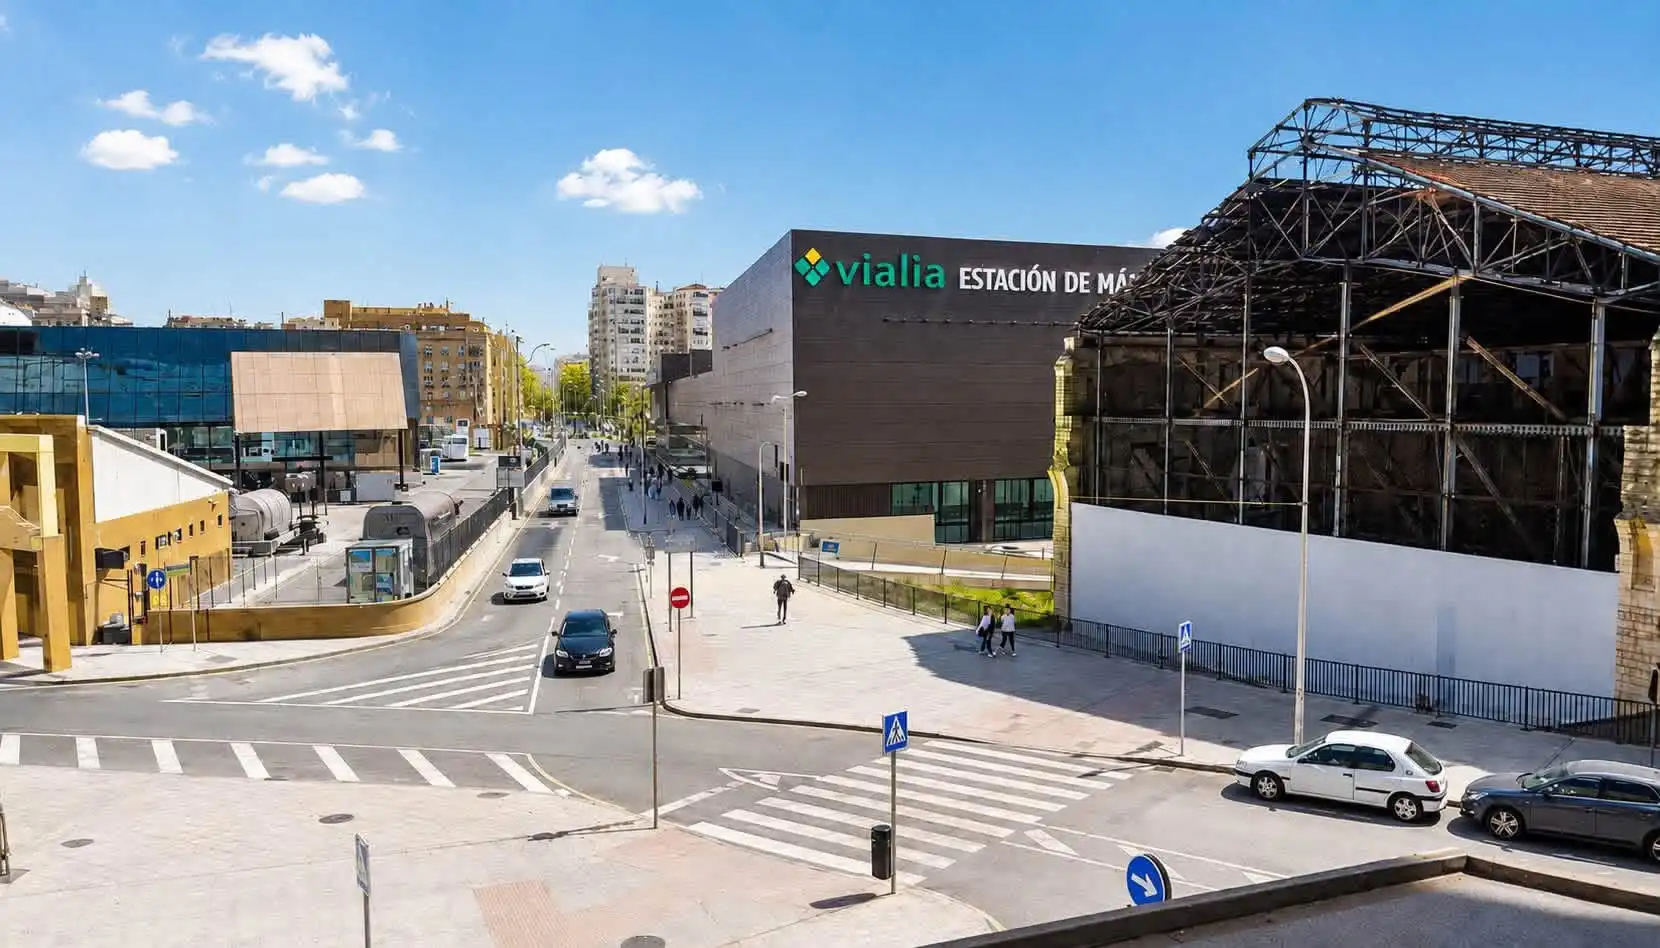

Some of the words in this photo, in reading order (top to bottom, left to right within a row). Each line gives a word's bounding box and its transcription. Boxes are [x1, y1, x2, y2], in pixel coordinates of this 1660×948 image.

[835, 252, 946, 288] vialia
[959, 263, 1056, 292] ESTACIÓN
[1064, 271, 1091, 293] DE
[1097, 267, 1136, 294] MÁ
